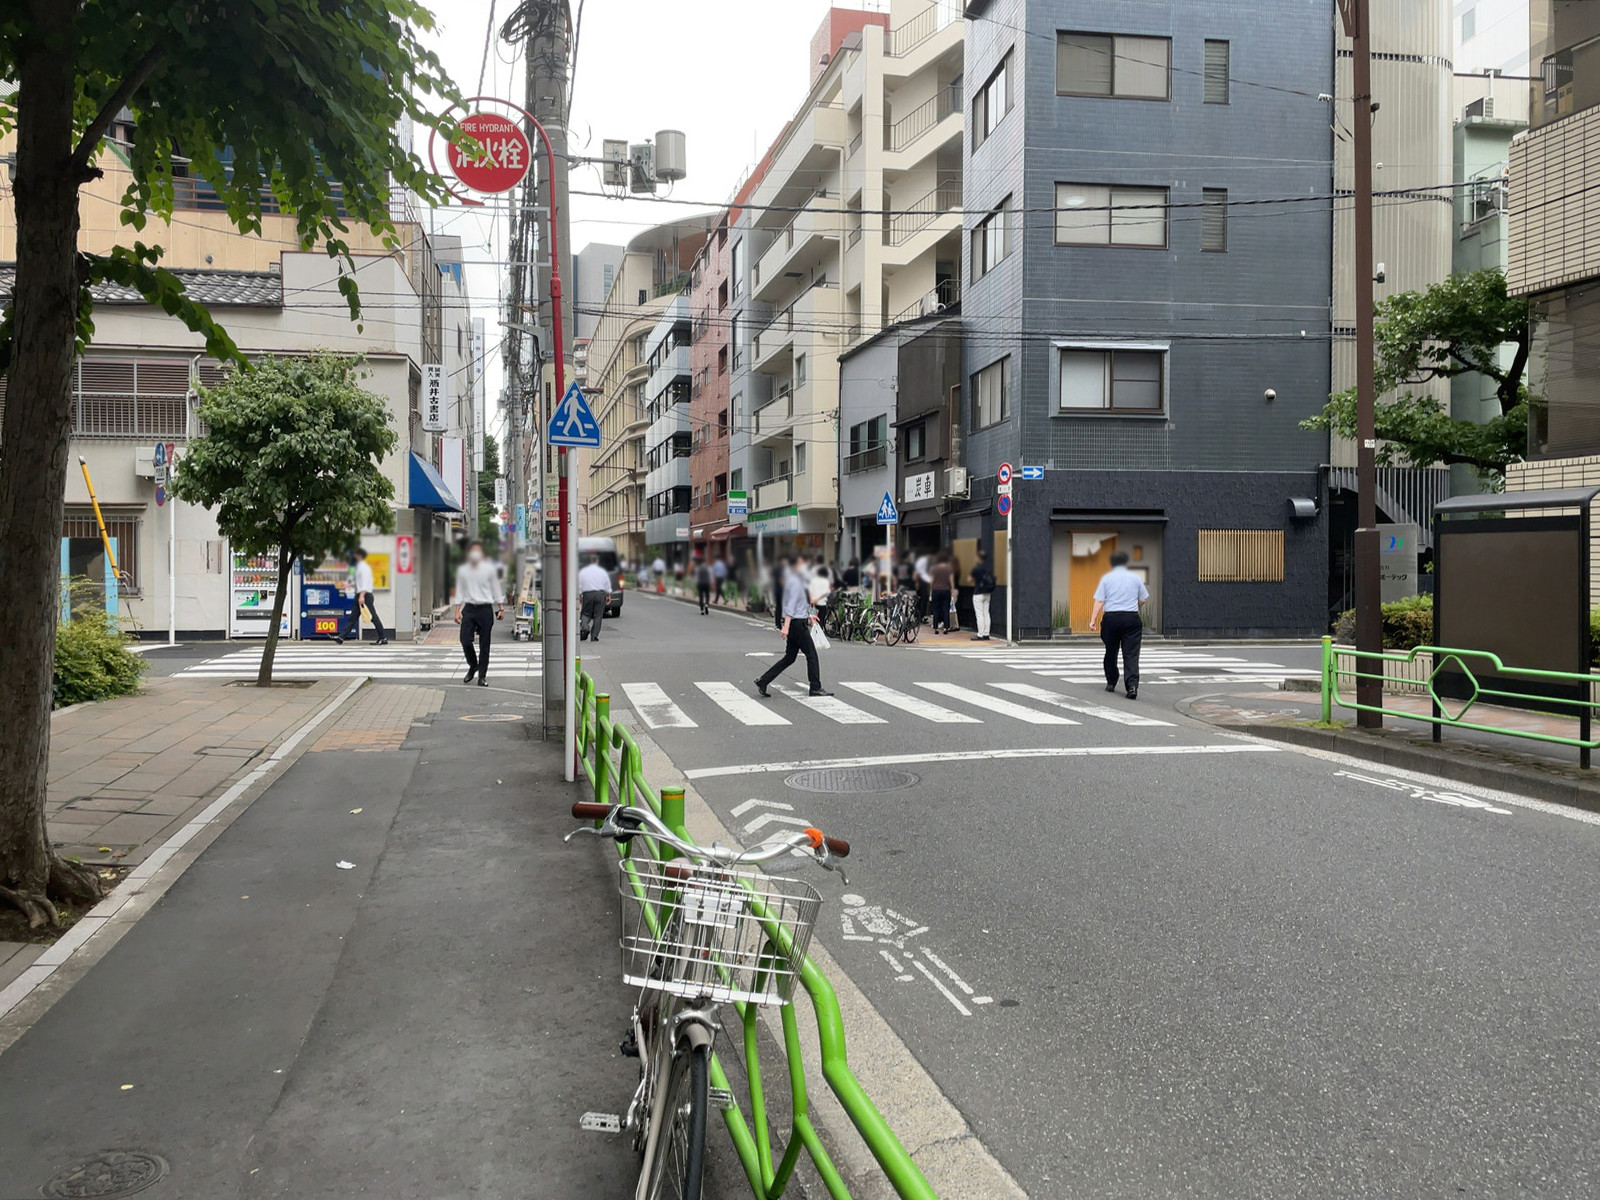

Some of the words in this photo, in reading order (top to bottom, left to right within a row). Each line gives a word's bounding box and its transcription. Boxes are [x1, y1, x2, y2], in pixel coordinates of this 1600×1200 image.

[460, 123, 477, 132] FIRE
[479, 123, 514, 133] HYDRANT
[428, 379, 440, 422] 酒井古書店
[316, 621, 336, 631] 100
